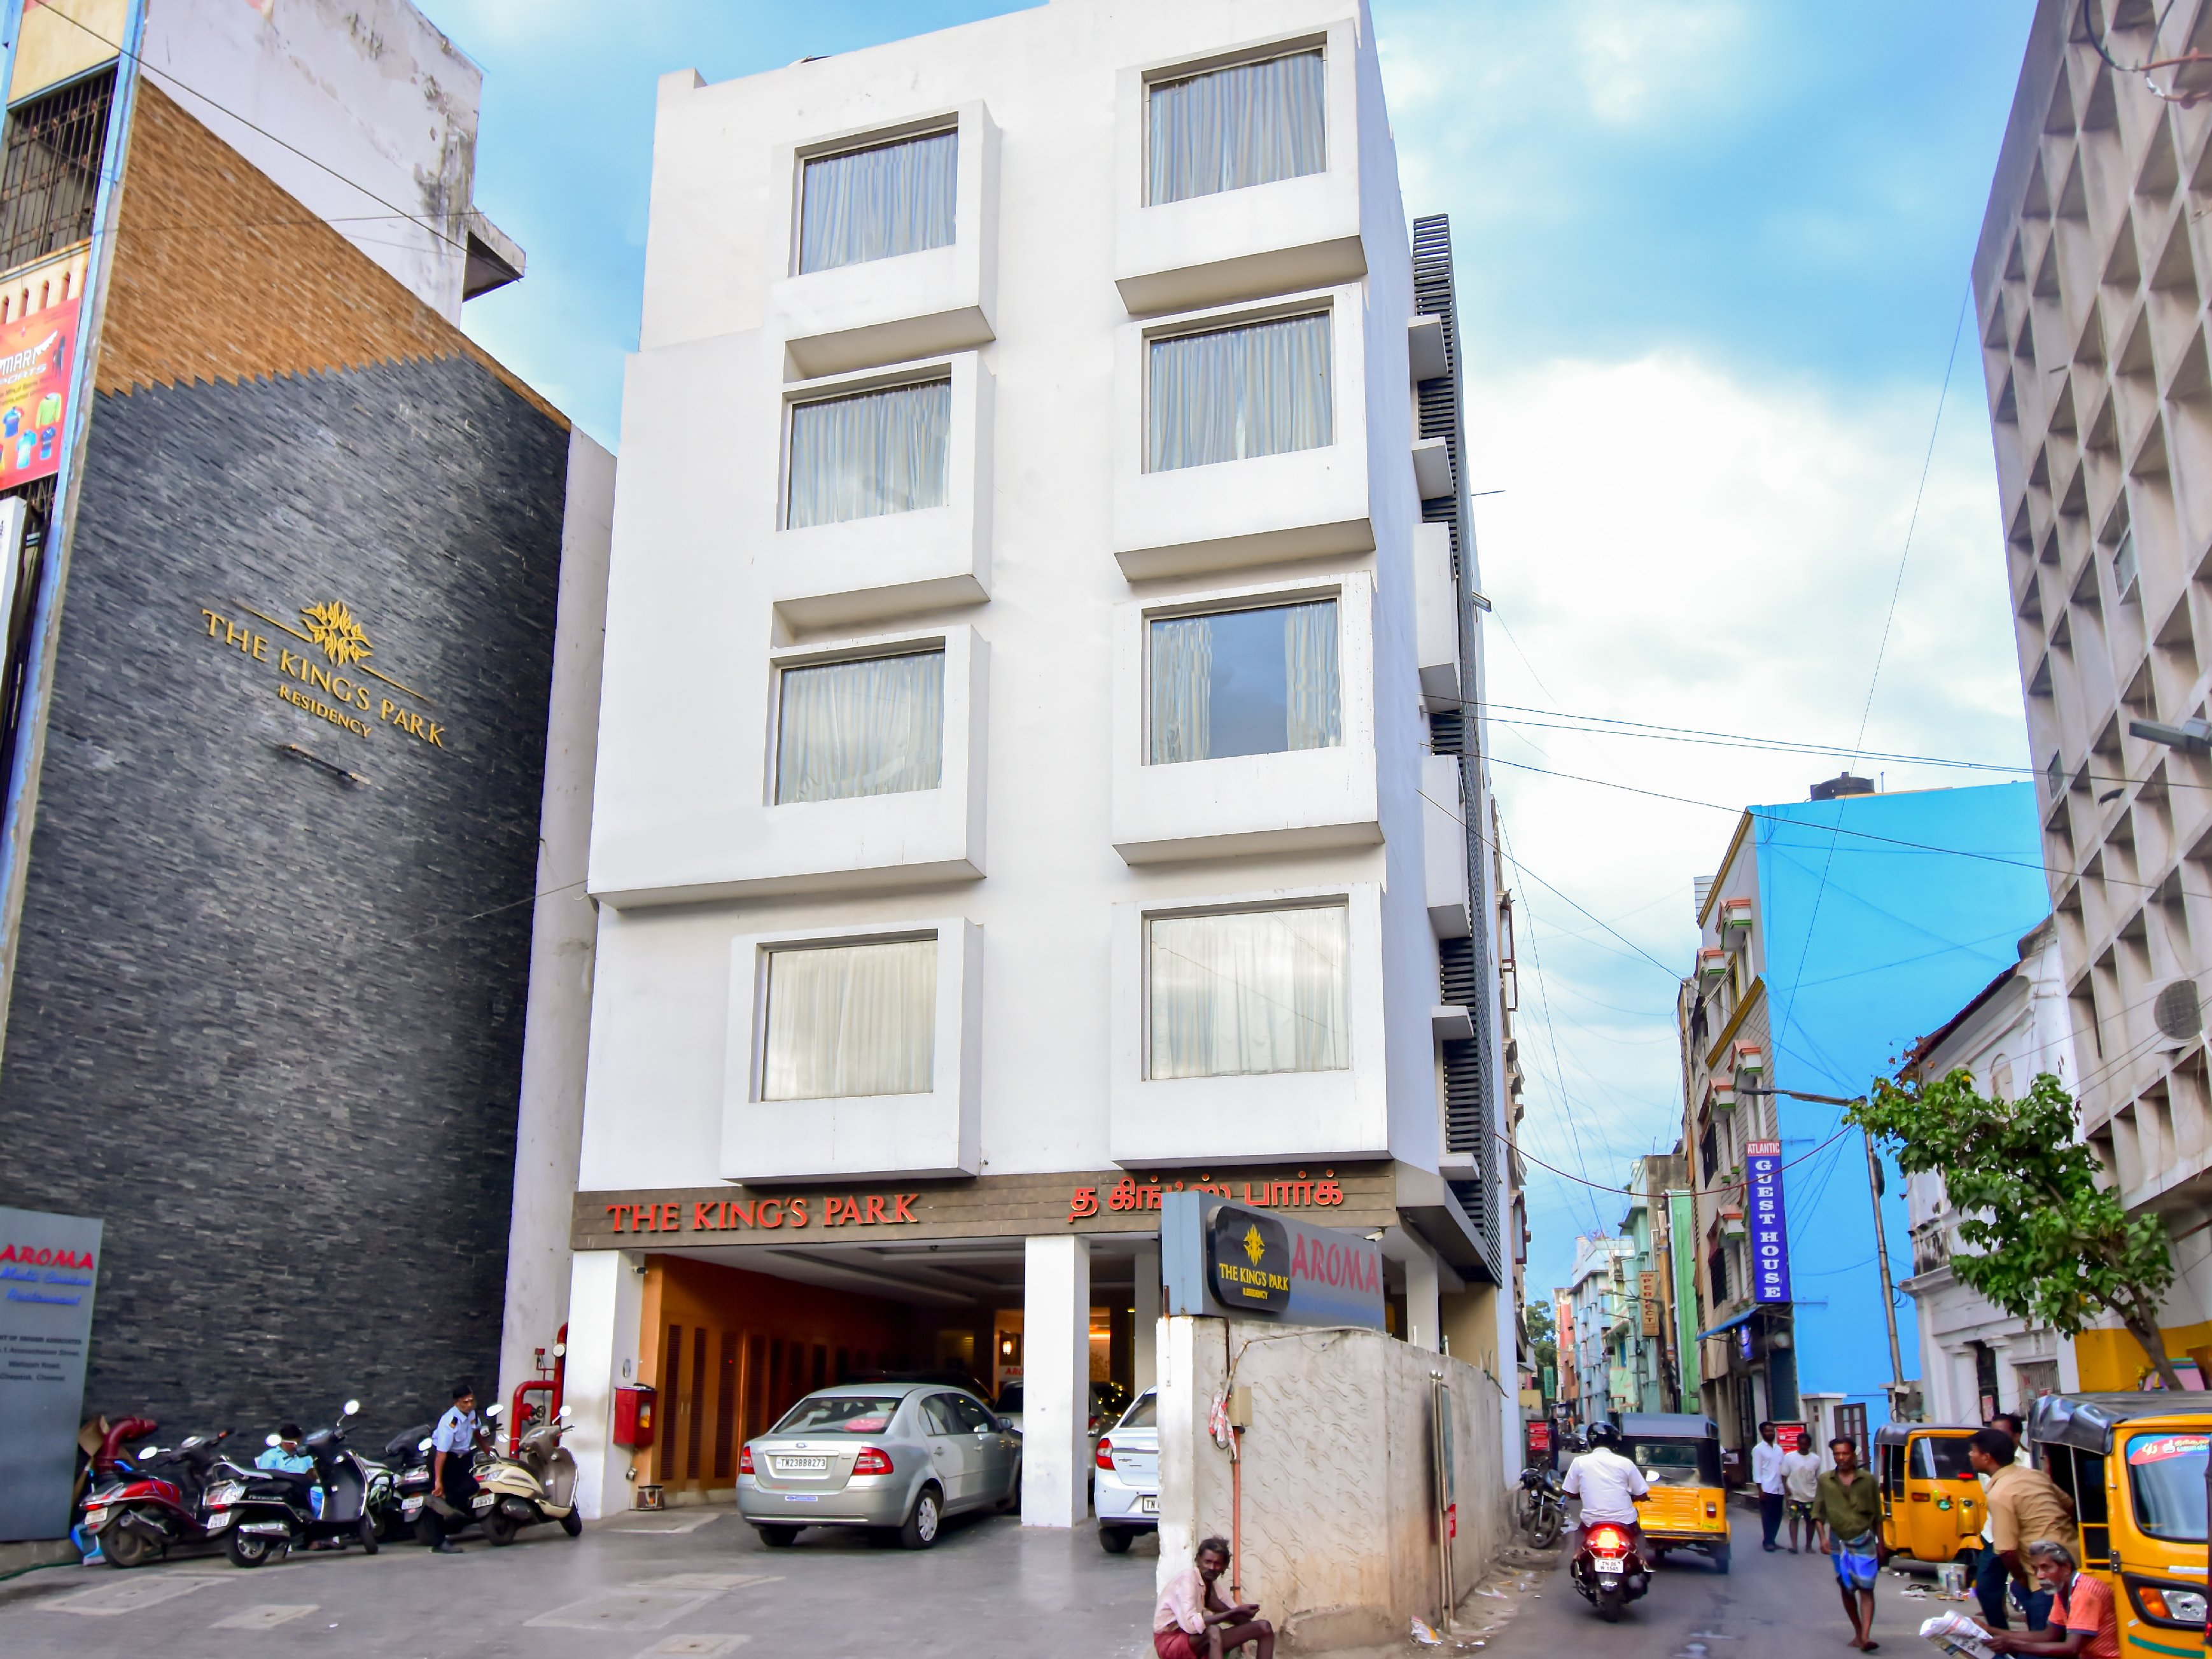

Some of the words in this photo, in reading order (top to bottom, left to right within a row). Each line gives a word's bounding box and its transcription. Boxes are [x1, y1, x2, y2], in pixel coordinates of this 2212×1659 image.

[201, 608, 269, 662] THE
[279, 648, 370, 711] KING'S
[381, 698, 445, 748] PARK
[279, 683, 372, 739] RESIDENCY
[1747, 1142, 1780, 1154] ATLANTIC
[606, 1202, 680, 1232] THE
[694, 1197, 808, 1230] KING'S
[824, 1193, 920, 1227] PARK
[1067, 1187, 1098, 1223] த
[1244, 1169, 1343, 1207] பார்க்
[1755, 1159, 1775, 1225] GUEST
[0, 1243, 94, 1271] AROMA
[1219, 1263, 1238, 1282] THE
[1240, 1267, 1267, 1287] KING'S
[1268, 1273, 1289, 1291] PARK
[1291, 1231, 1380, 1296] AROMA
[1760, 1231, 1781, 1298] HOUSE
